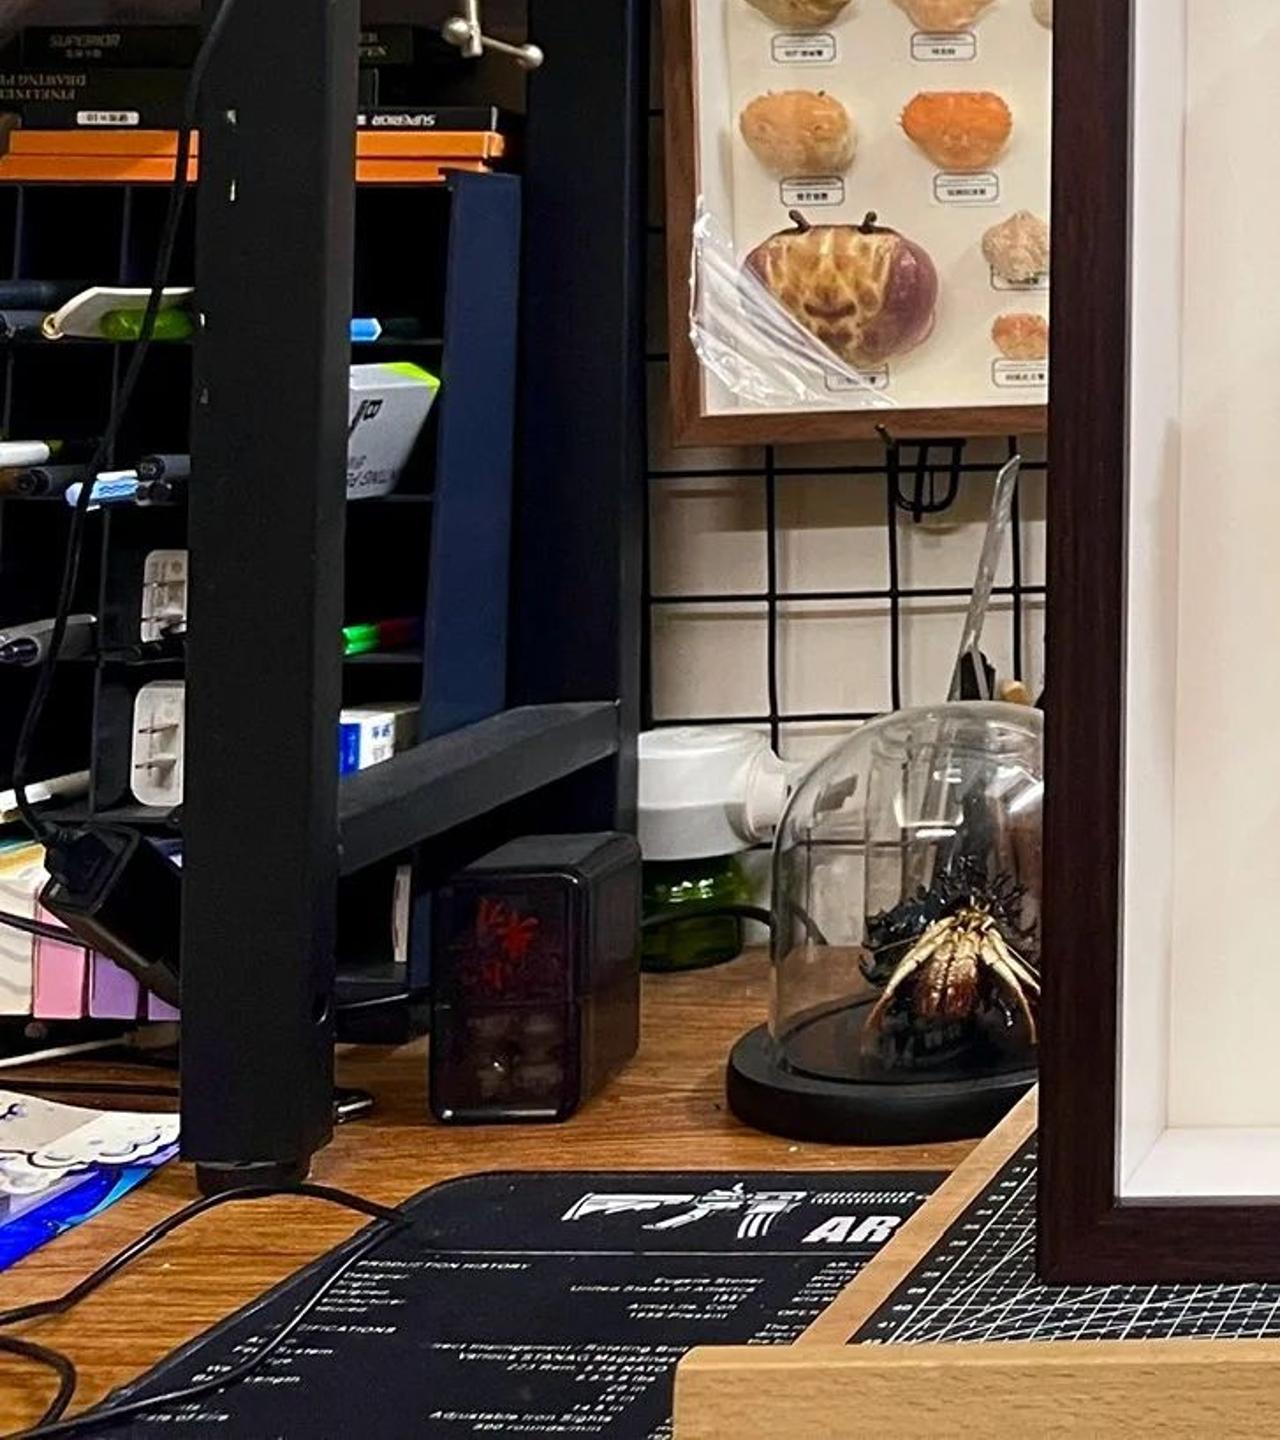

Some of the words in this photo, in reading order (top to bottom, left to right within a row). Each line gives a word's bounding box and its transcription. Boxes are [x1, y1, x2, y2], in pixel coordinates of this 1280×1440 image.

[801, 1216, 901, 1243] AR
[461, 1261, 532, 1270] HISTORY
[654, 1277, 711, 1286] Eugene
[570, 1284, 621, 1292] United
[622, 1285, 671, 1293] States
[673, 1285, 692, 1293] of
[692, 1285, 756, 1293] America
[519, 1353, 590, 1363] STANAG
[592, 1354, 678, 1365] Magazines
[620, 1365, 669, 1374] NATO
[428, 1410, 519, 1422] Adjustable
[520, 1413, 556, 1422] Iron
[558, 1413, 614, 1426] Sights
